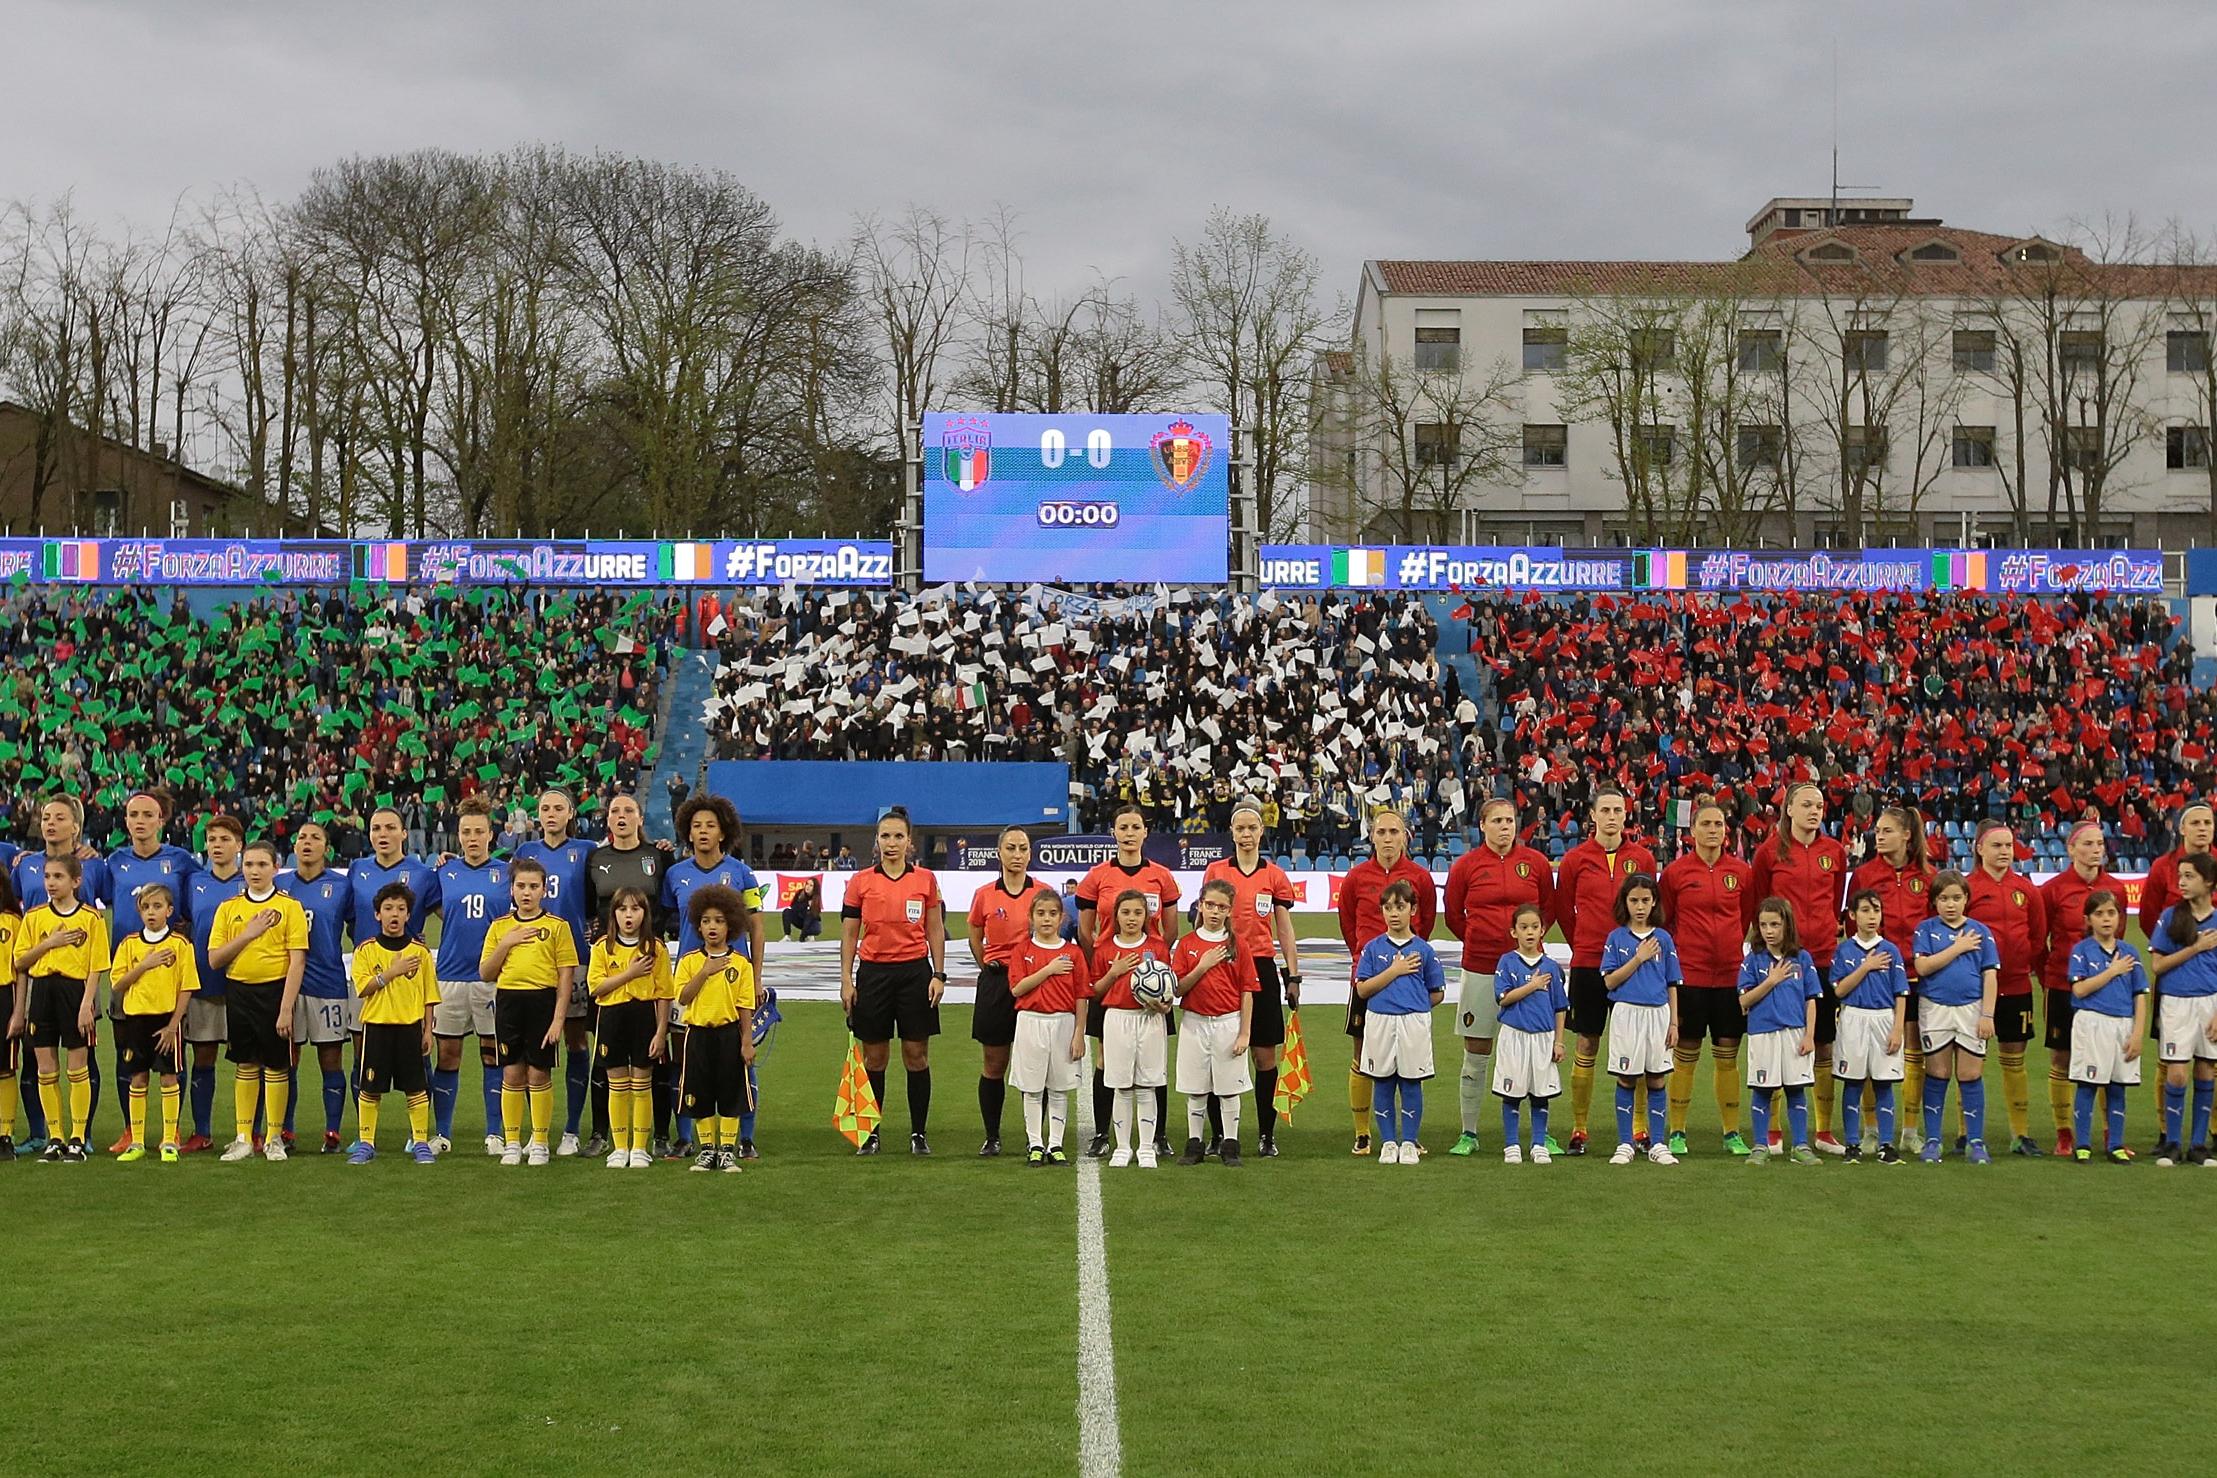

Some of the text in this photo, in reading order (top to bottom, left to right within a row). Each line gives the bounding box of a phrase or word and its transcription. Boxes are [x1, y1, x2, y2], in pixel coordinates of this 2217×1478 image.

[1040, 505, 1117, 524] 00:00
[1260, 561, 1319, 584] URRE
[1042, 587, 1098, 611] FORZA
[1189, 850, 1222, 859] FRANCE
[1189, 858, 1208, 866] 2019
[543, 875, 560, 898] 3
[461, 894, 484, 919] 19
[320, 1005, 342, 1029] 13
